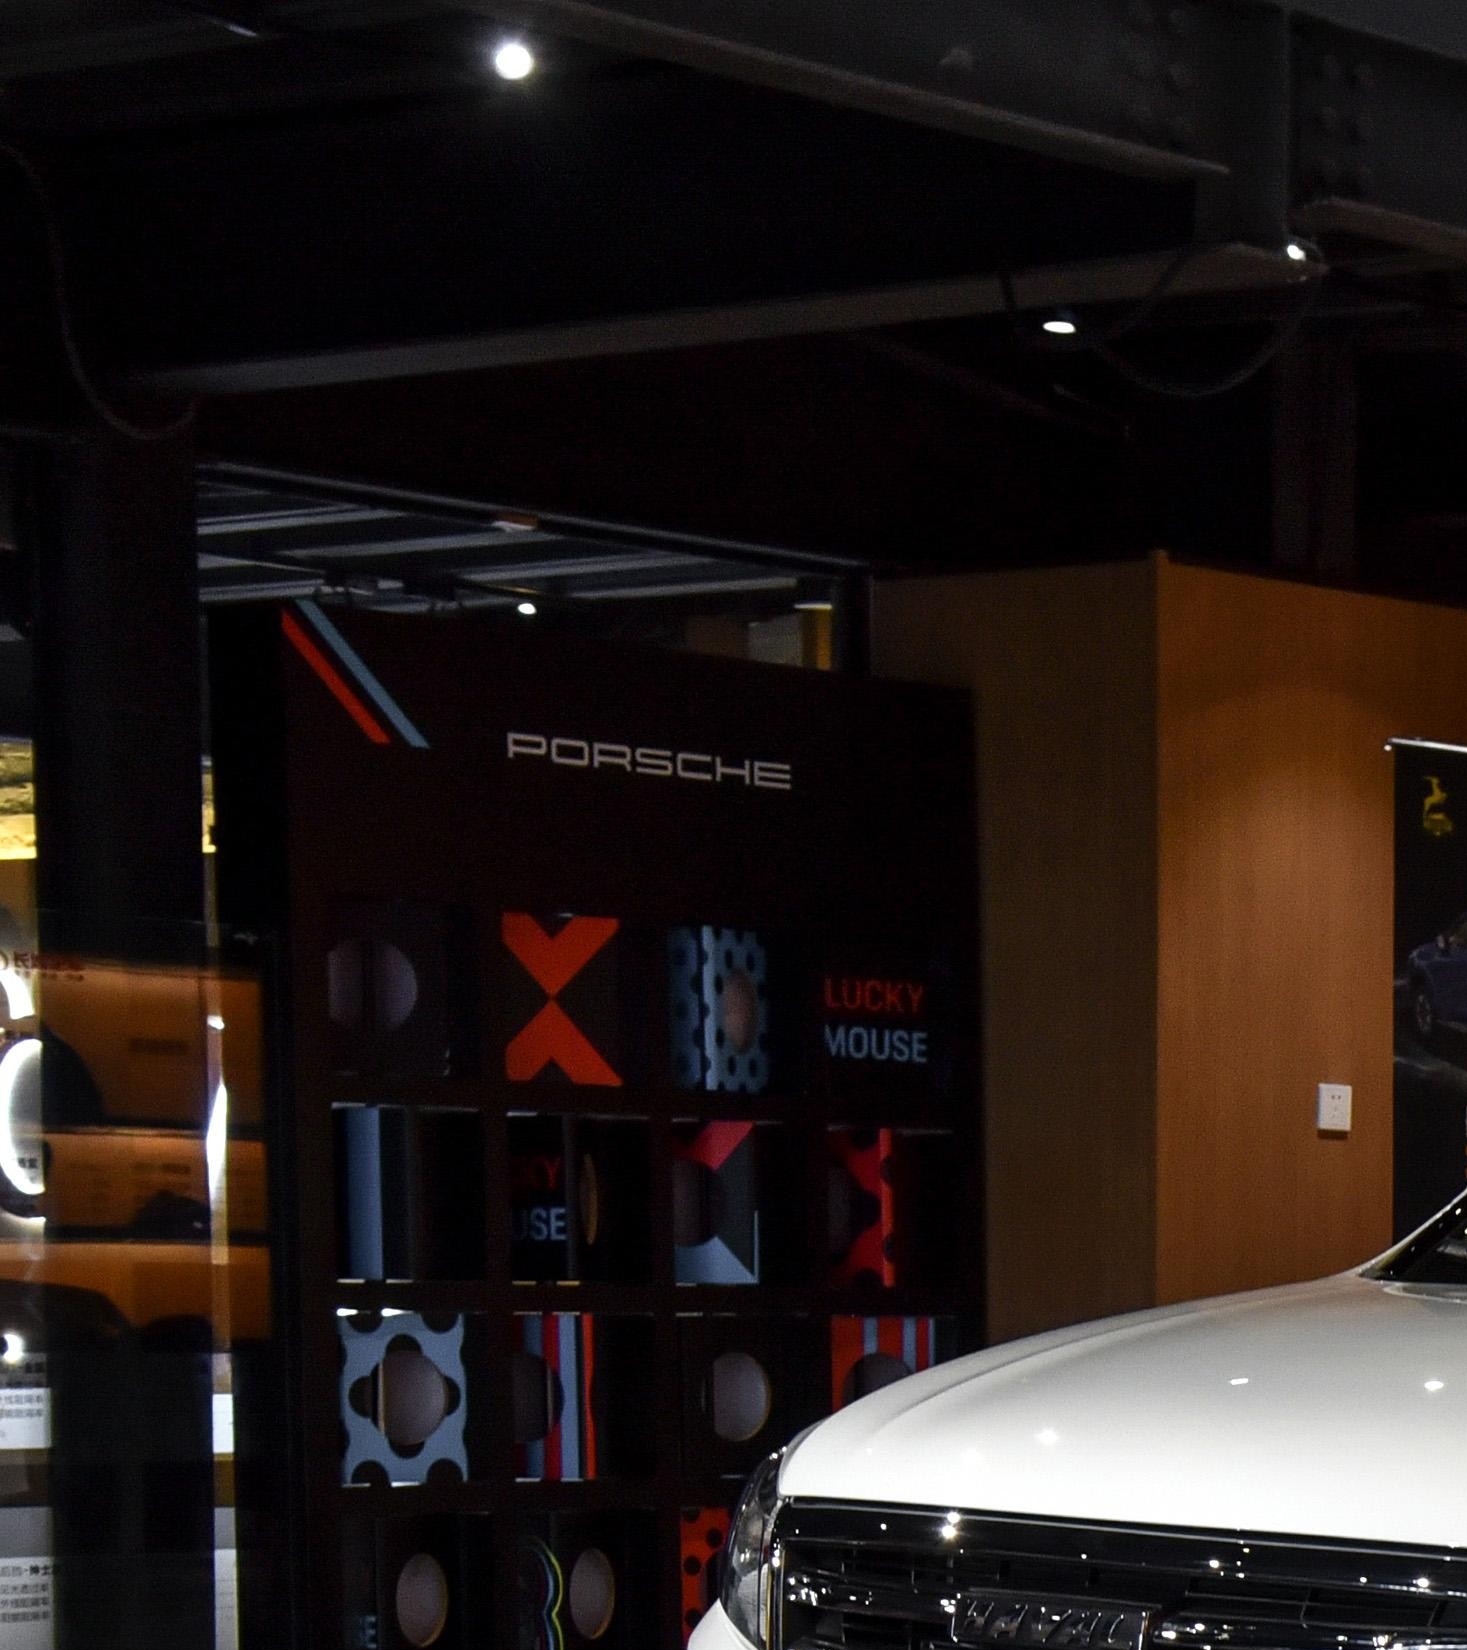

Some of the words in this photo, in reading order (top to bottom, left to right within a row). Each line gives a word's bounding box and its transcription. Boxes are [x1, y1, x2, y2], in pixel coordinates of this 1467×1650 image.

[506, 731, 793, 791] PORSCHE
[823, 973, 927, 1016] LUCKY
[823, 1024, 929, 1064] MOUSE
